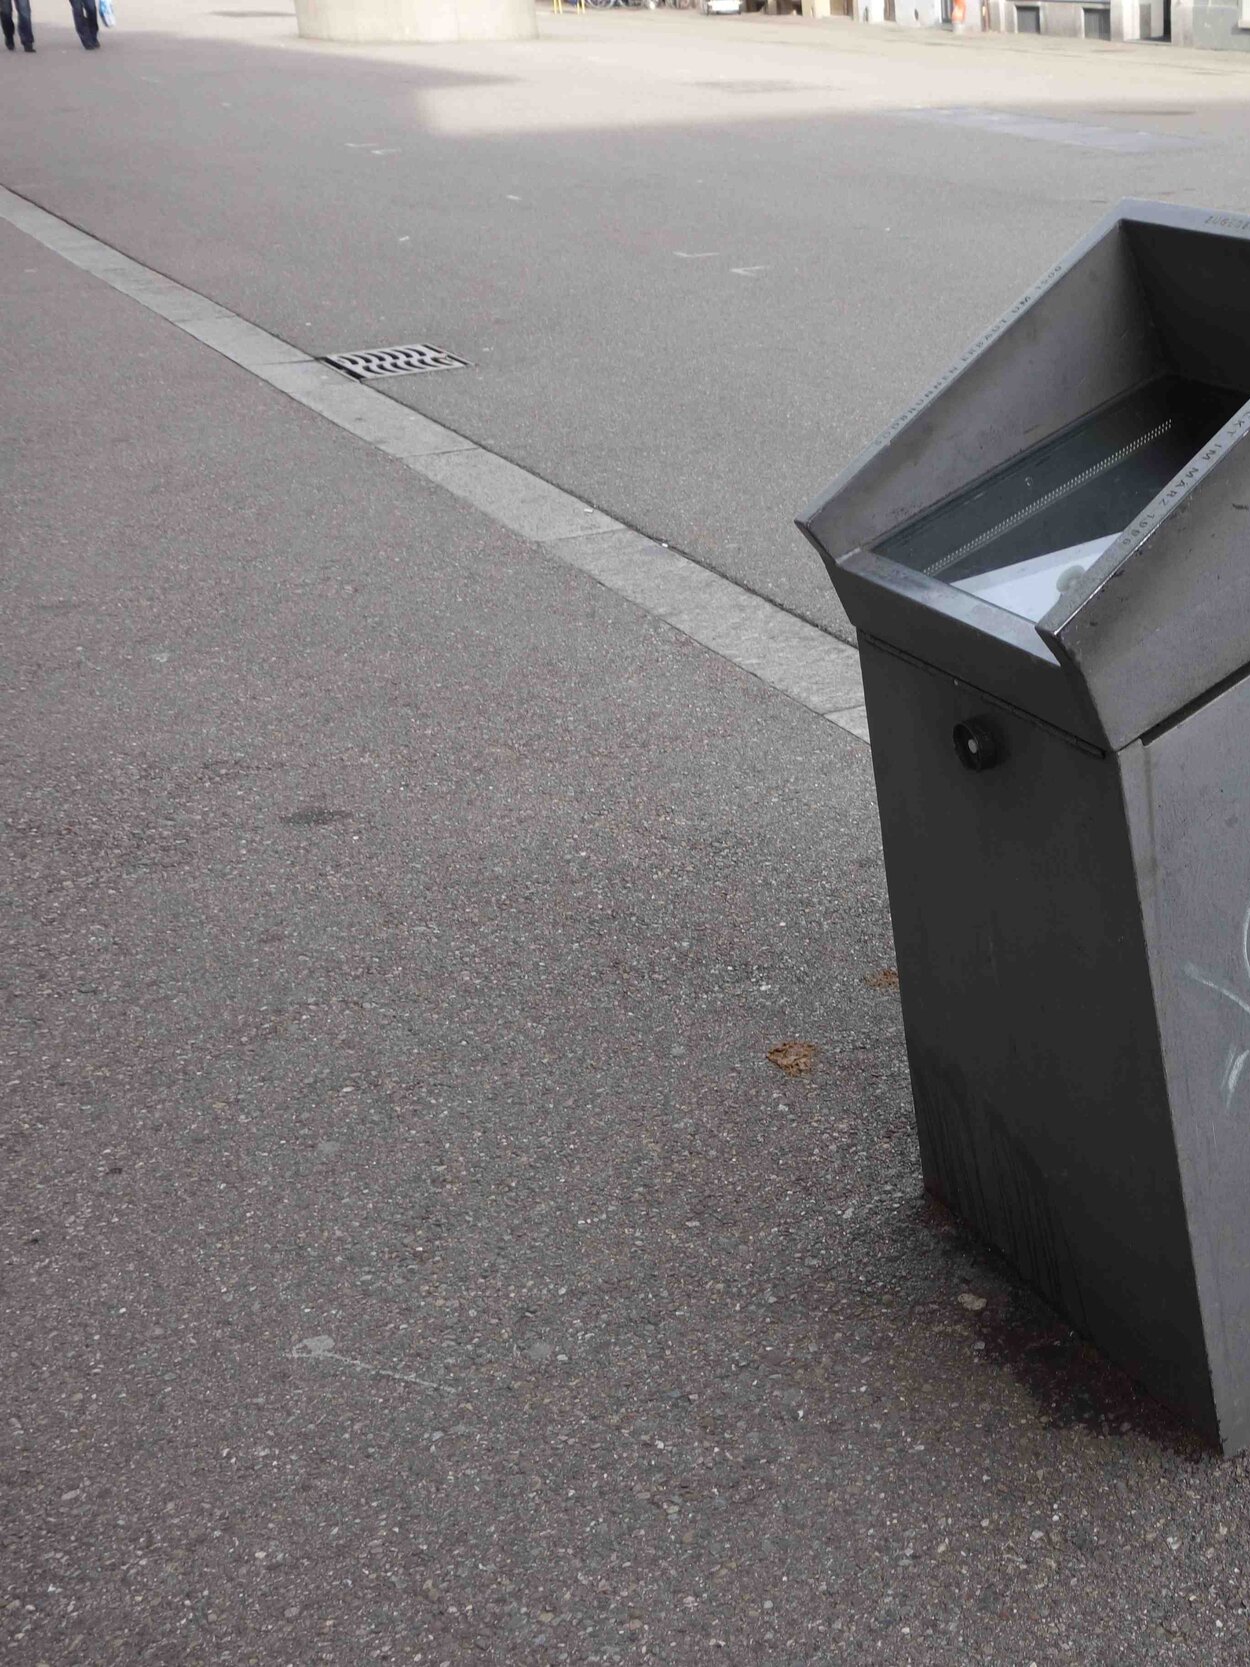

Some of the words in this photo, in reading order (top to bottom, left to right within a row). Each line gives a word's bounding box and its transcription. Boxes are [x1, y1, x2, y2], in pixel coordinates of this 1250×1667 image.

[873, 365, 959, 447] SODBRUNNEN
[961, 317, 1009, 362] ERBAUT
[1011, 295, 1032, 314] UM
[1201, 443, 1223, 462] IM
[1158, 466, 1200, 506] MÄRZ
[1120, 512, 1156, 545] 1996
